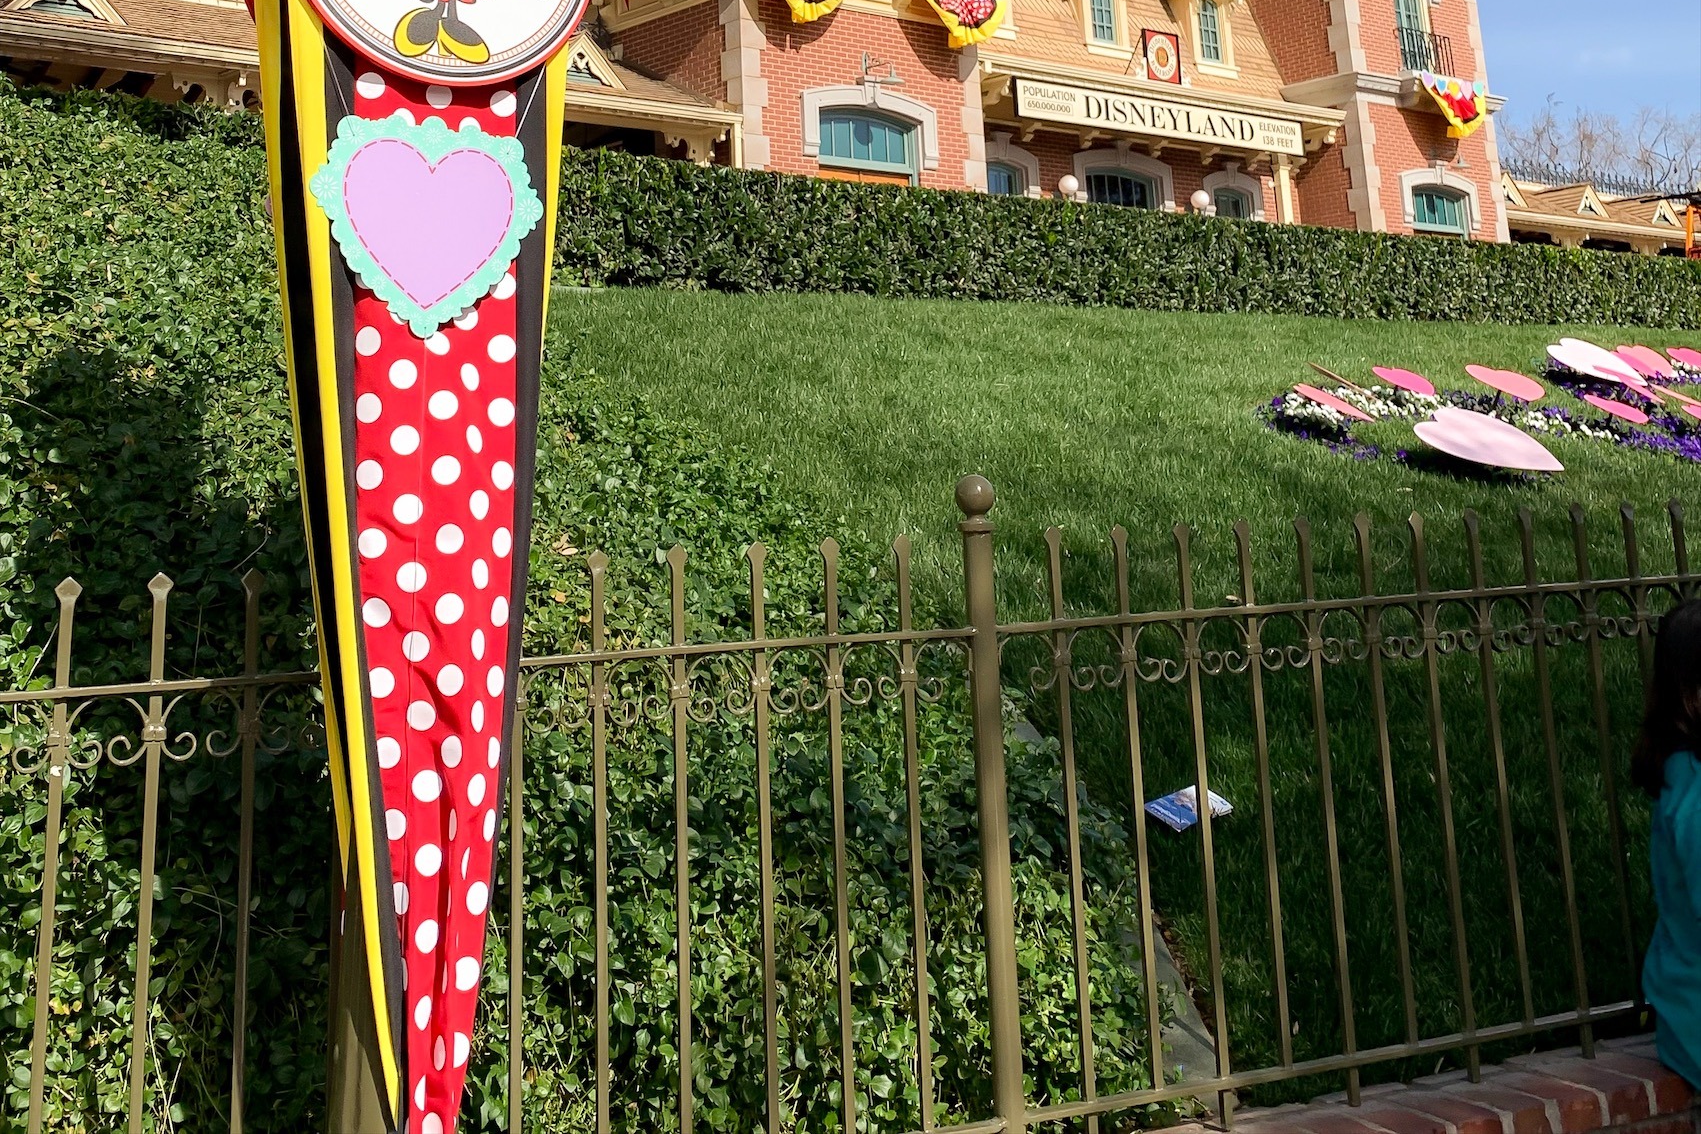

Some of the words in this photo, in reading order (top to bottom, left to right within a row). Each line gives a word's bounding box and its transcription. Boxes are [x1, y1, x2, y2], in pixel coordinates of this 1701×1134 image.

[1023, 85, 1076, 102] POPULATION
[1082, 94, 1255, 142] DISNEYLAND
[1258, 122, 1296, 136] ELEVATION
[1262, 135, 1275, 146] 138
[1276, 137, 1294, 148] FEET
